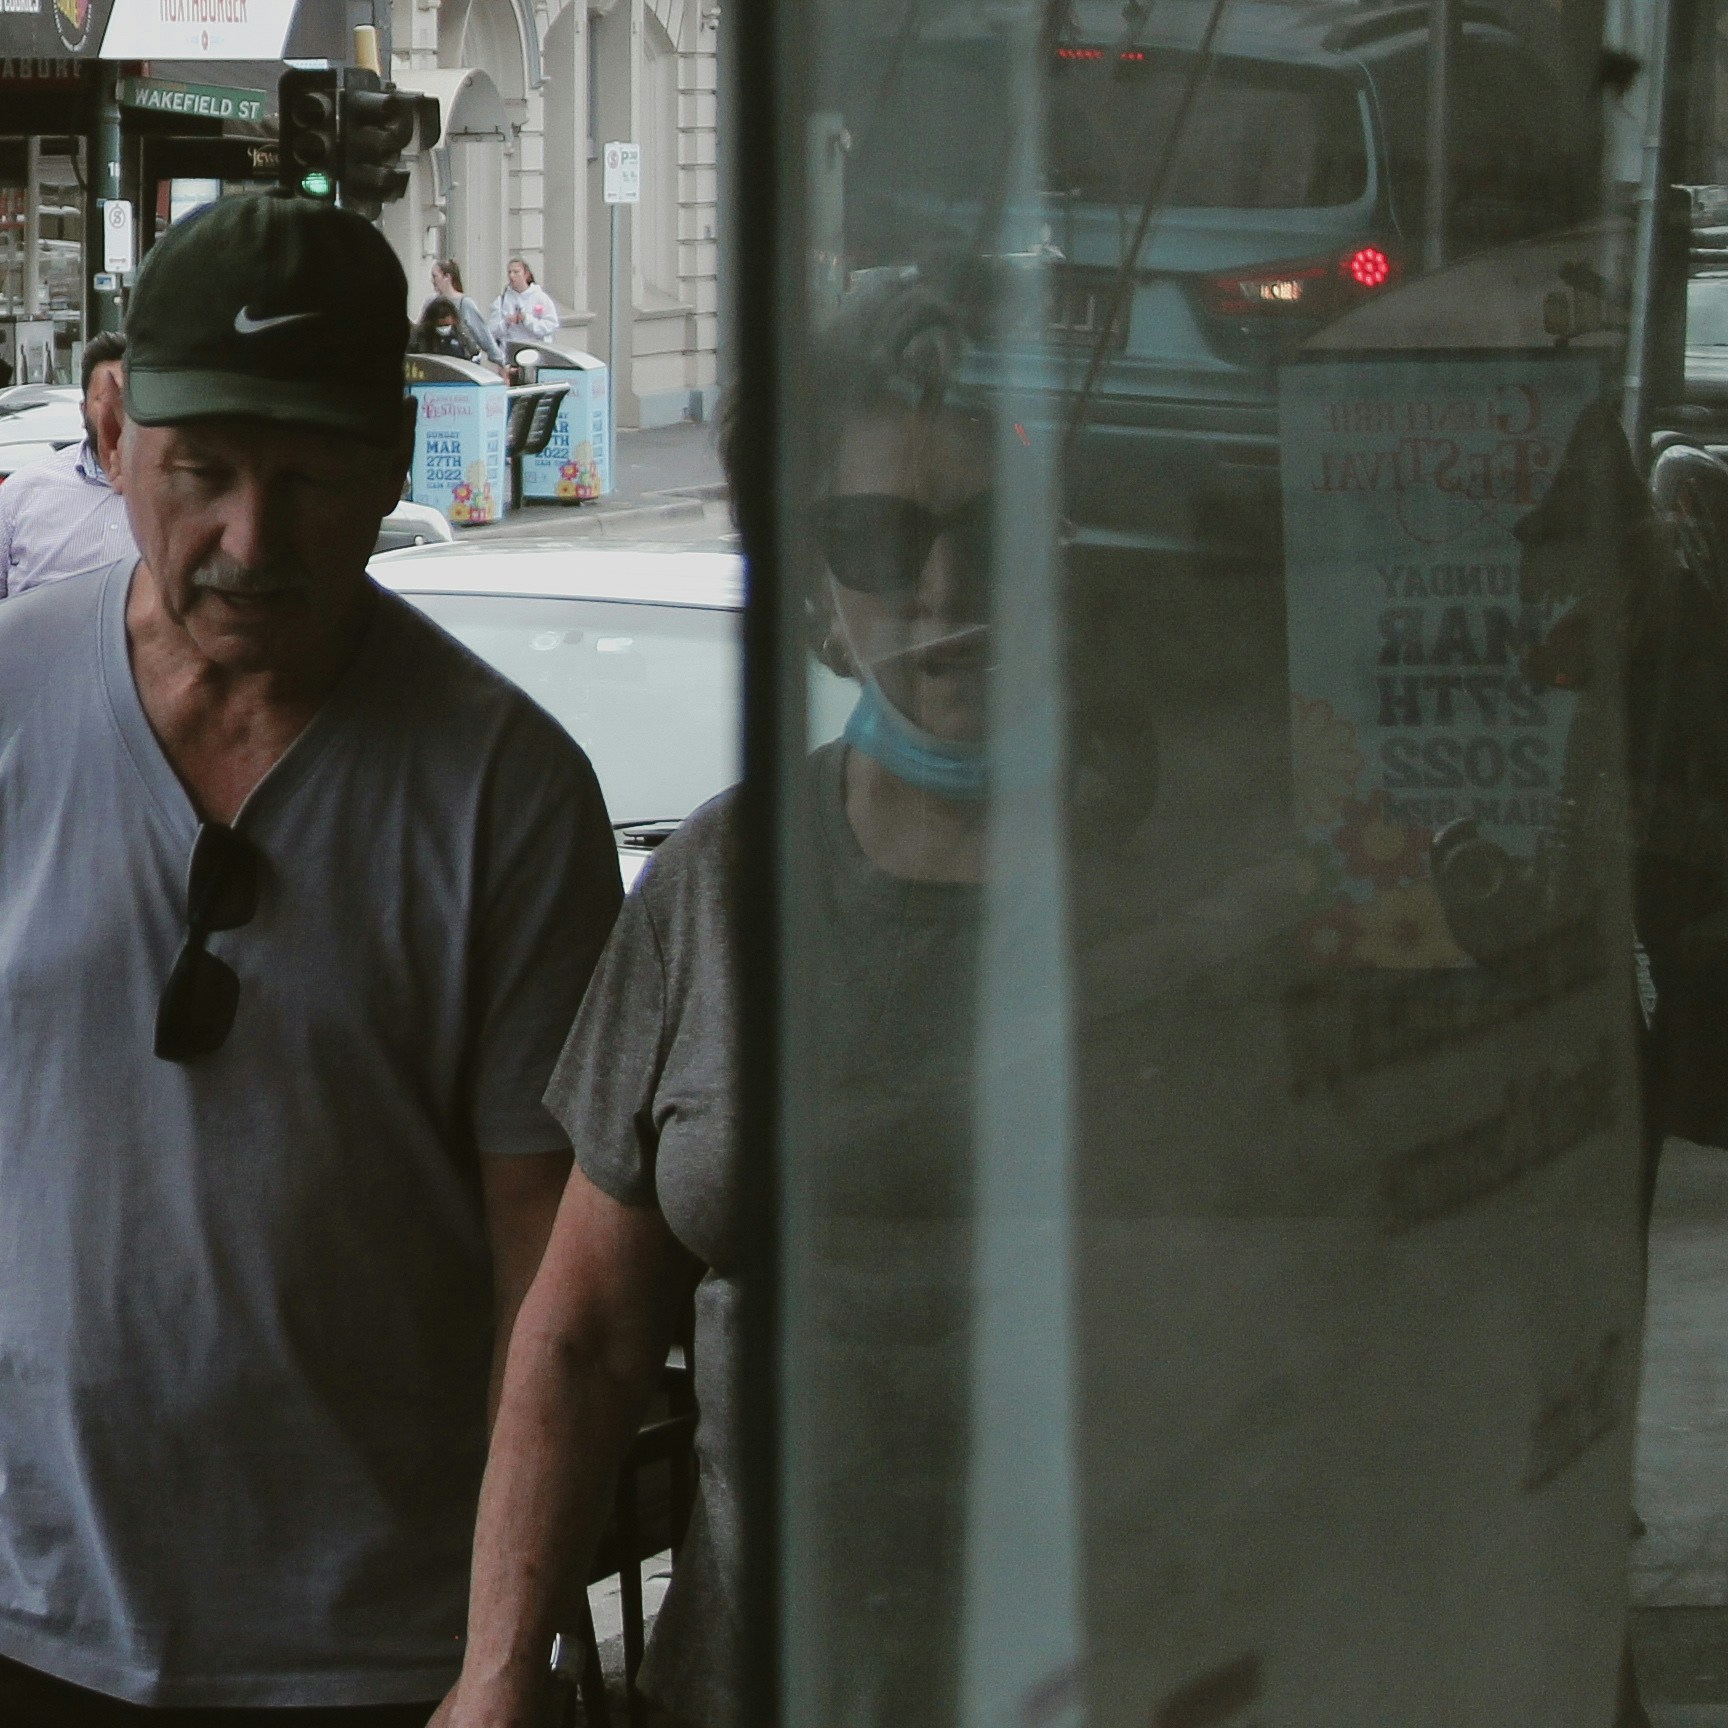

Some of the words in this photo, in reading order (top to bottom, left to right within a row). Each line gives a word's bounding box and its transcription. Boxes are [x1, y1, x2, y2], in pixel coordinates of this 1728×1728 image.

[135, 87, 233, 116] WAKEFIELD
[238, 100, 261, 119] ST
[426, 441, 461, 453] MAR
[426, 455, 462, 467] 27TH
[426, 468, 462, 481] 2022
